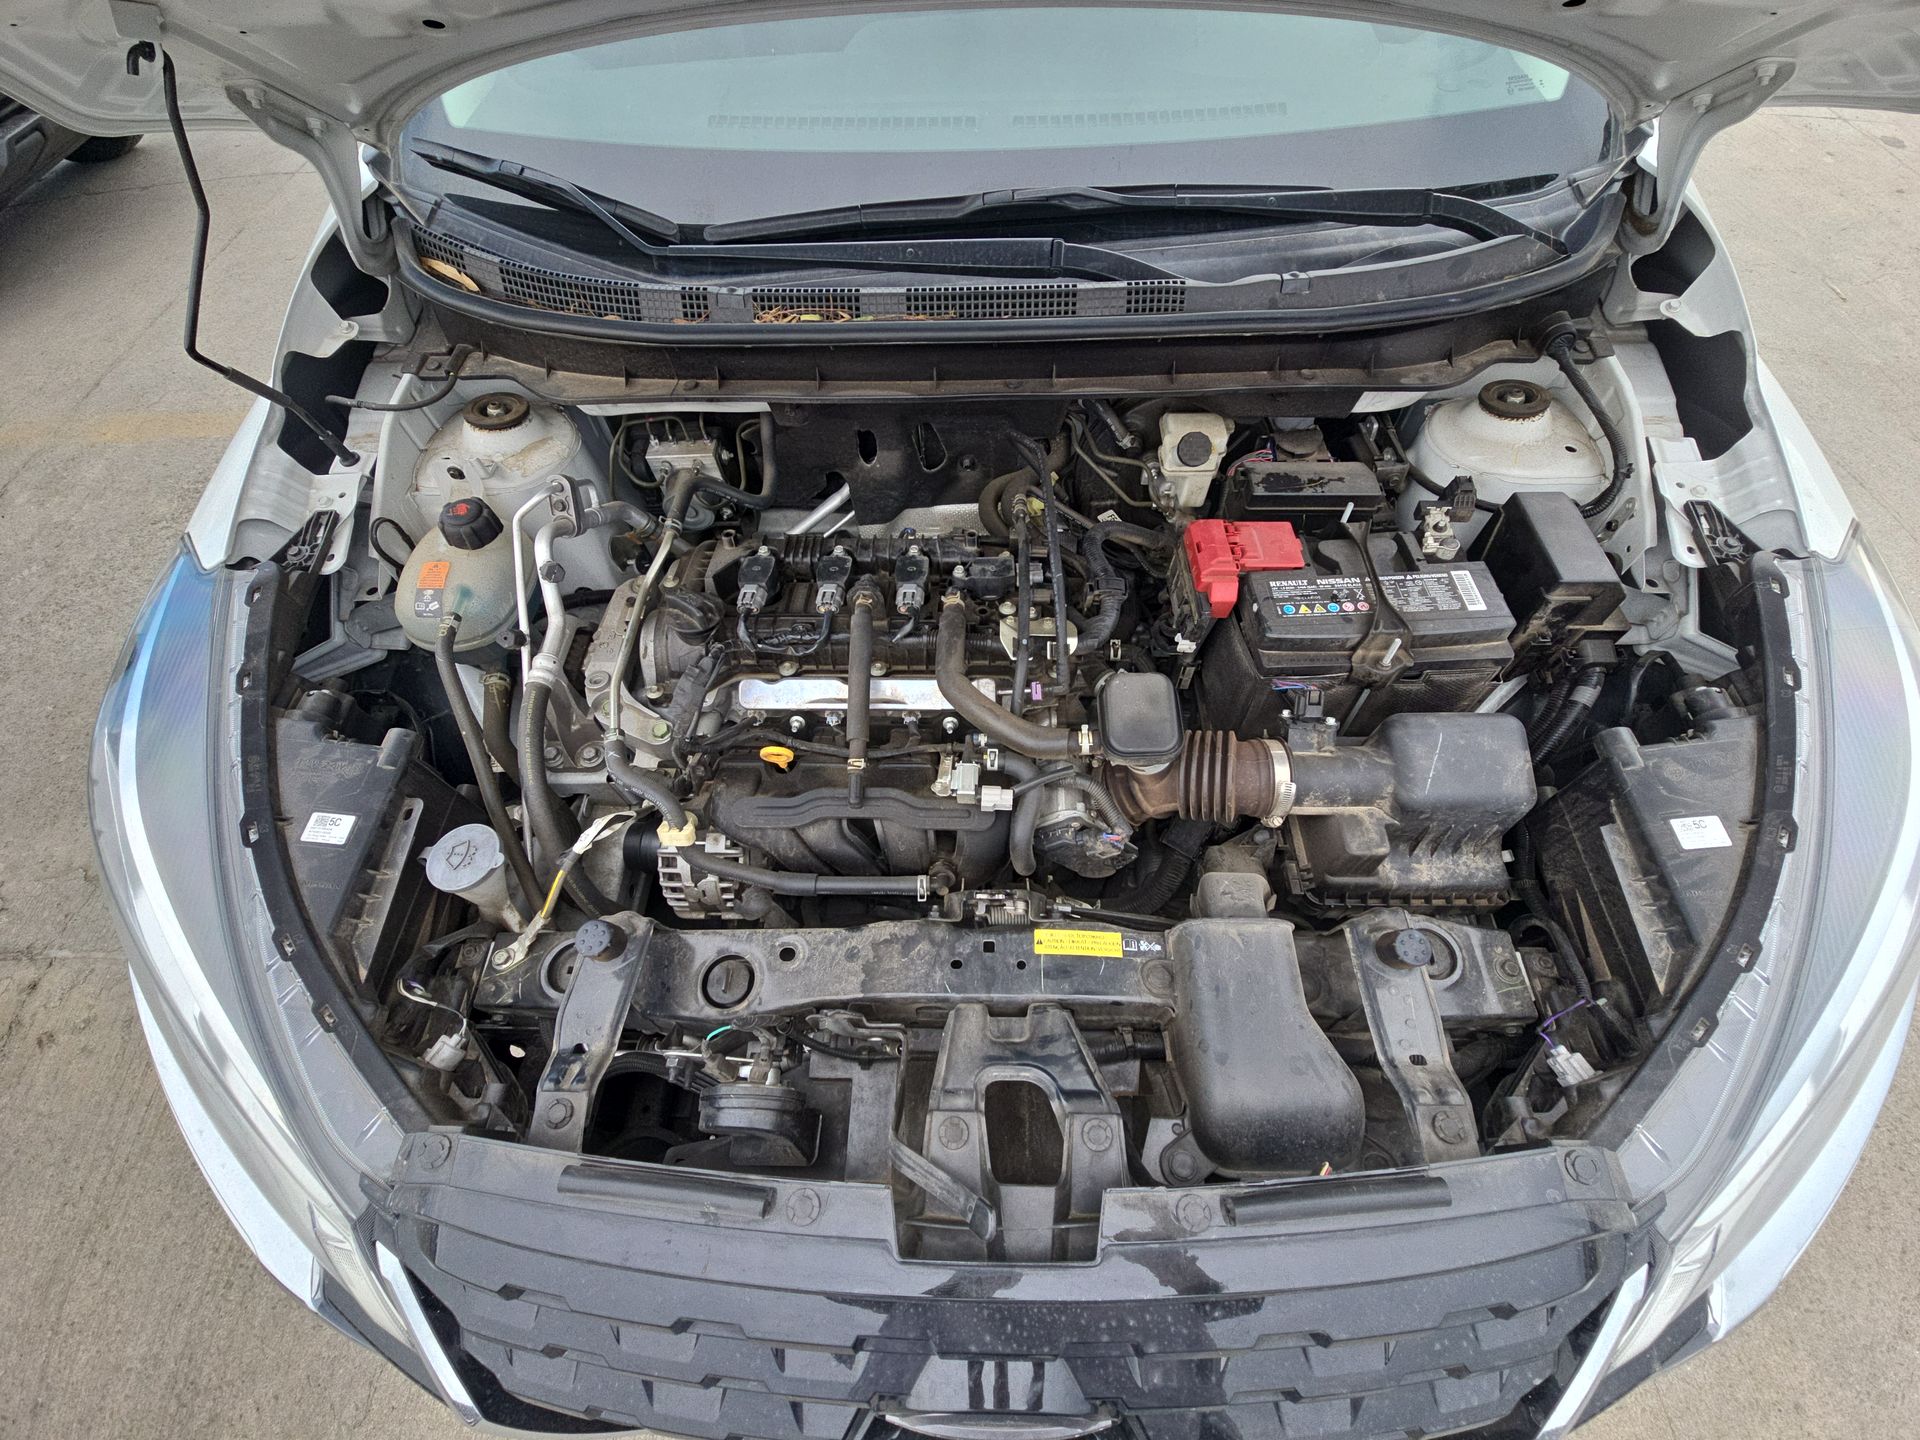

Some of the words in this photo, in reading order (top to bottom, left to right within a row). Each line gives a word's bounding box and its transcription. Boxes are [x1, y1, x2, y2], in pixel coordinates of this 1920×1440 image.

[1316, 577, 1361, 585] NISSAN
[328, 817, 342, 827] 5C
[1692, 819, 1707, 829] 5C
